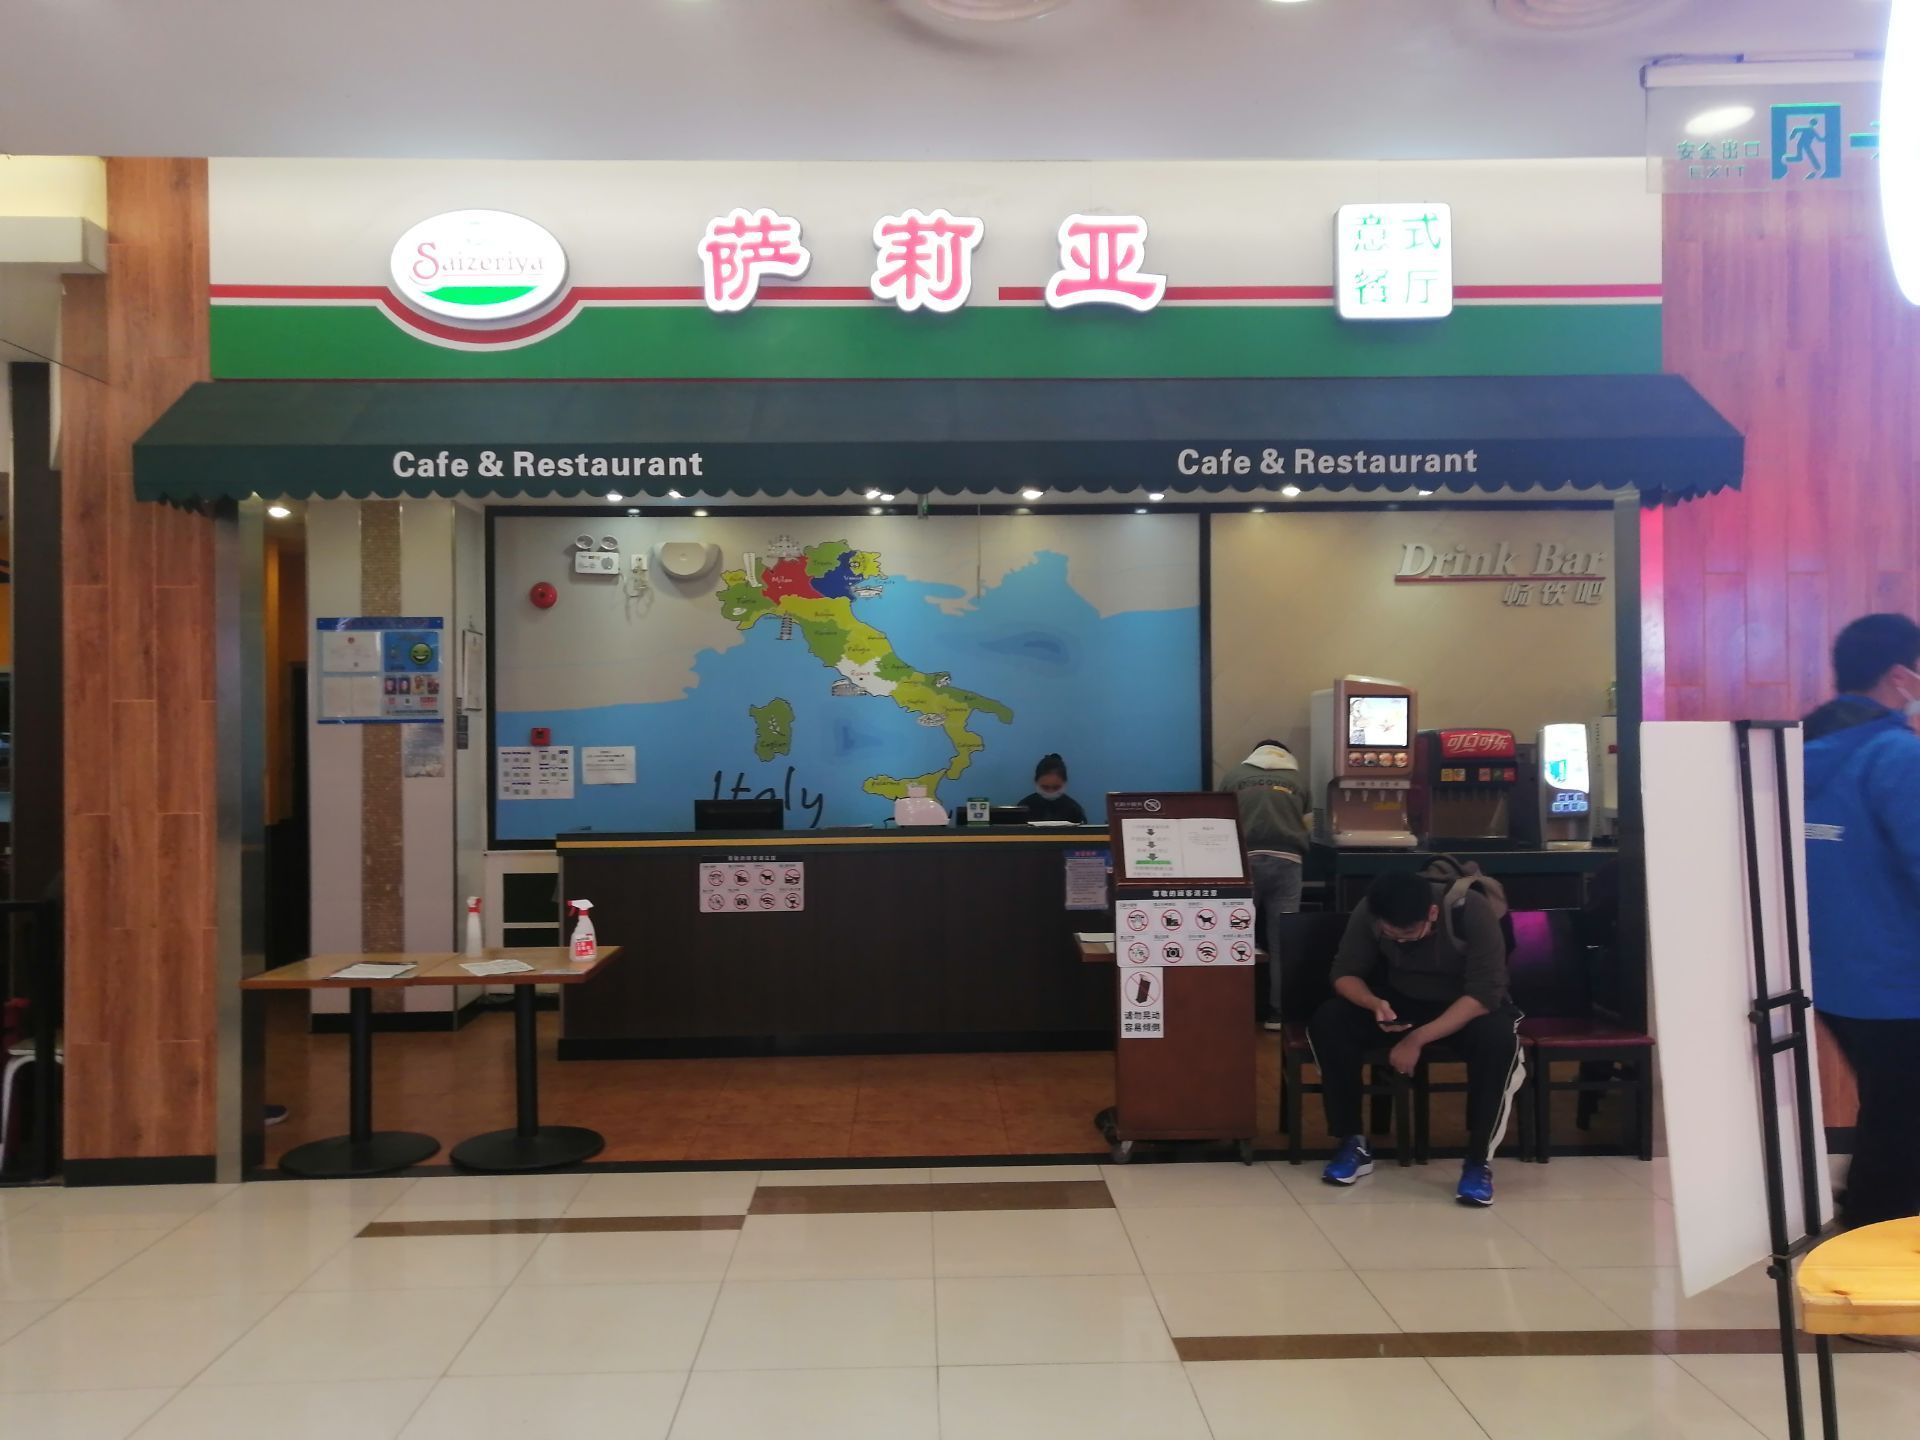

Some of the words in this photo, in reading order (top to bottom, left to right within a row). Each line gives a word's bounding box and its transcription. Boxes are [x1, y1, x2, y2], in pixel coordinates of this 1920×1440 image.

[1677, 139, 1761, 160] 安全出口
[1689, 165, 1745, 178] EXIT
[411, 241, 544, 280] Saizeriya
[702, 212, 1161, 302] 萨莉亚
[392, 450, 469, 477] Cafe
[477, 450, 505, 477] &
[513, 451, 704, 477] Restaurant
[1177, 448, 1251, 475] Cafe
[1259, 448, 1286, 475] &
[1294, 448, 1478, 475] Restaurant
[1396, 542, 1521, 577] Drink
[1528, 542, 1610, 576] Bar
[1447, 733, 1511, 753] 可口可乐
